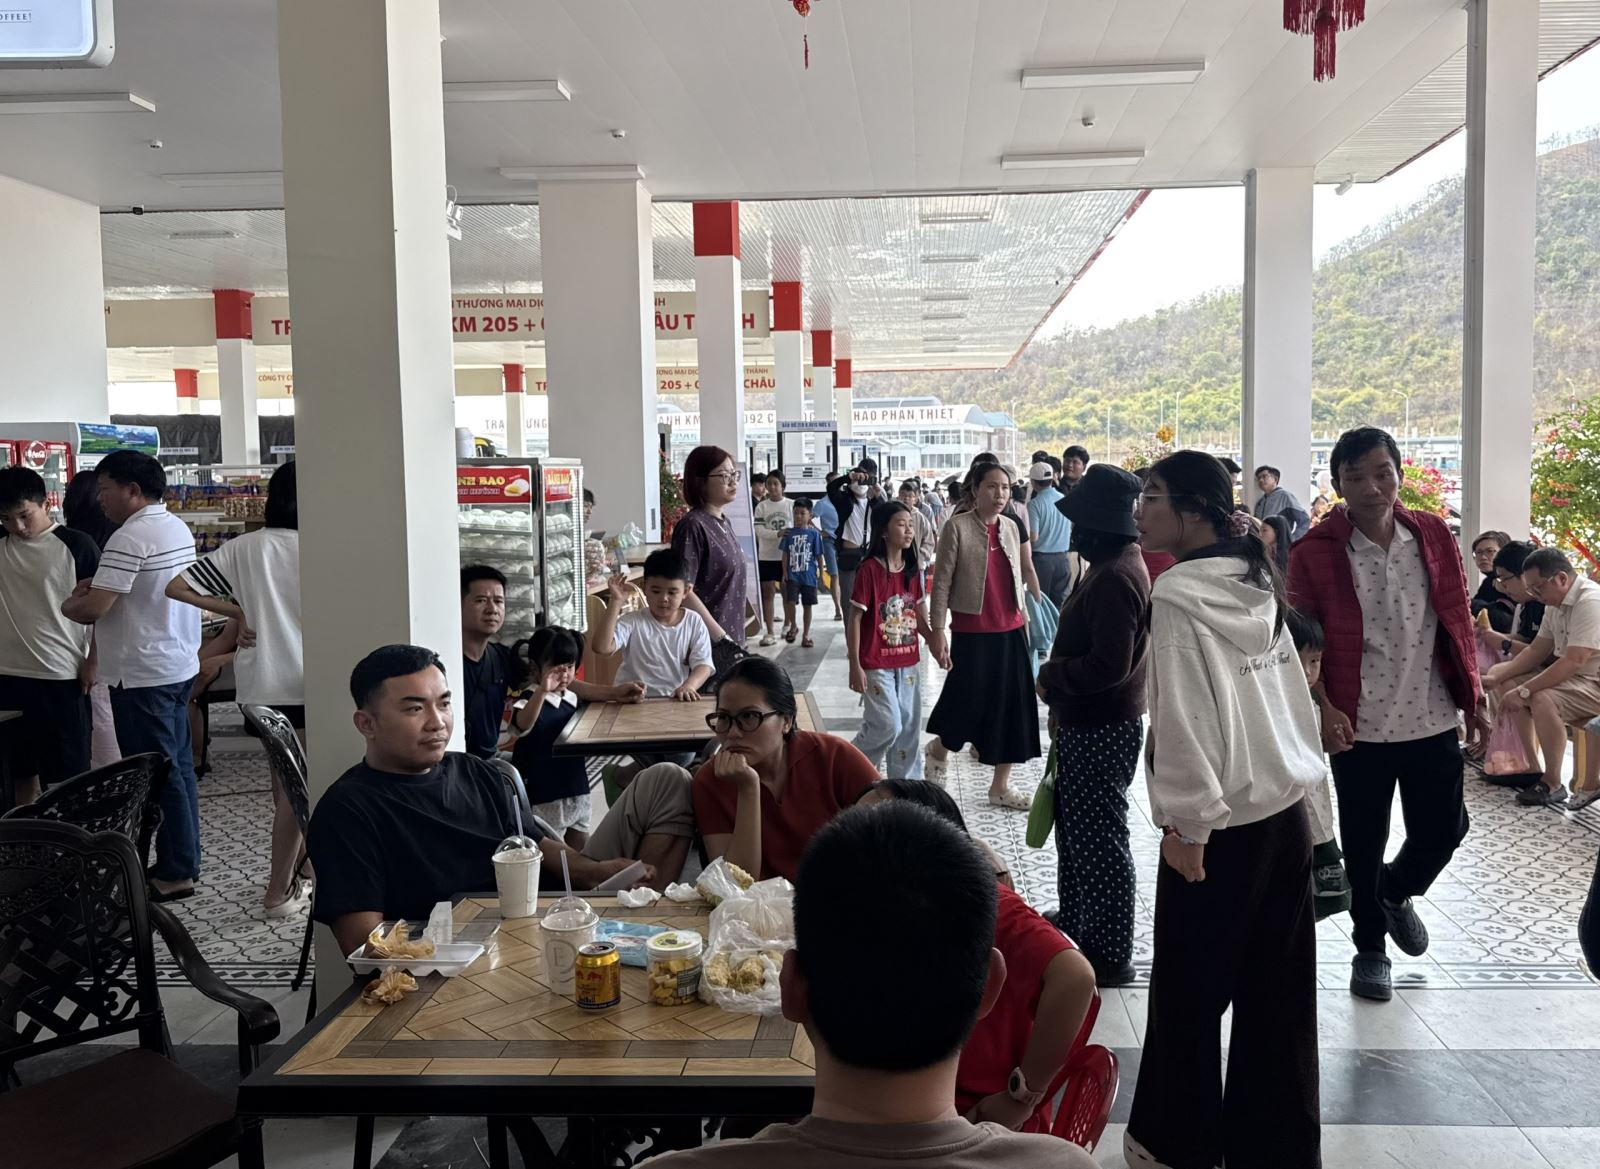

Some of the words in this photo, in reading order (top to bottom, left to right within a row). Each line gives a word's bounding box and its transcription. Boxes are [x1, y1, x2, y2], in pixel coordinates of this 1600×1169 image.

[0, 12, 32, 20] OFFEE!
[456, 298, 503, 309] THƯƠNG
[506, 299, 526, 310] MẠI
[482, 316, 518, 332] 205
[524, 319, 536, 332] +
[655, 311, 679, 330] ÂU
[660, 380, 682, 390] 205
[744, 376, 775, 388] CHÂU
[479, 476, 506, 486] BAO
